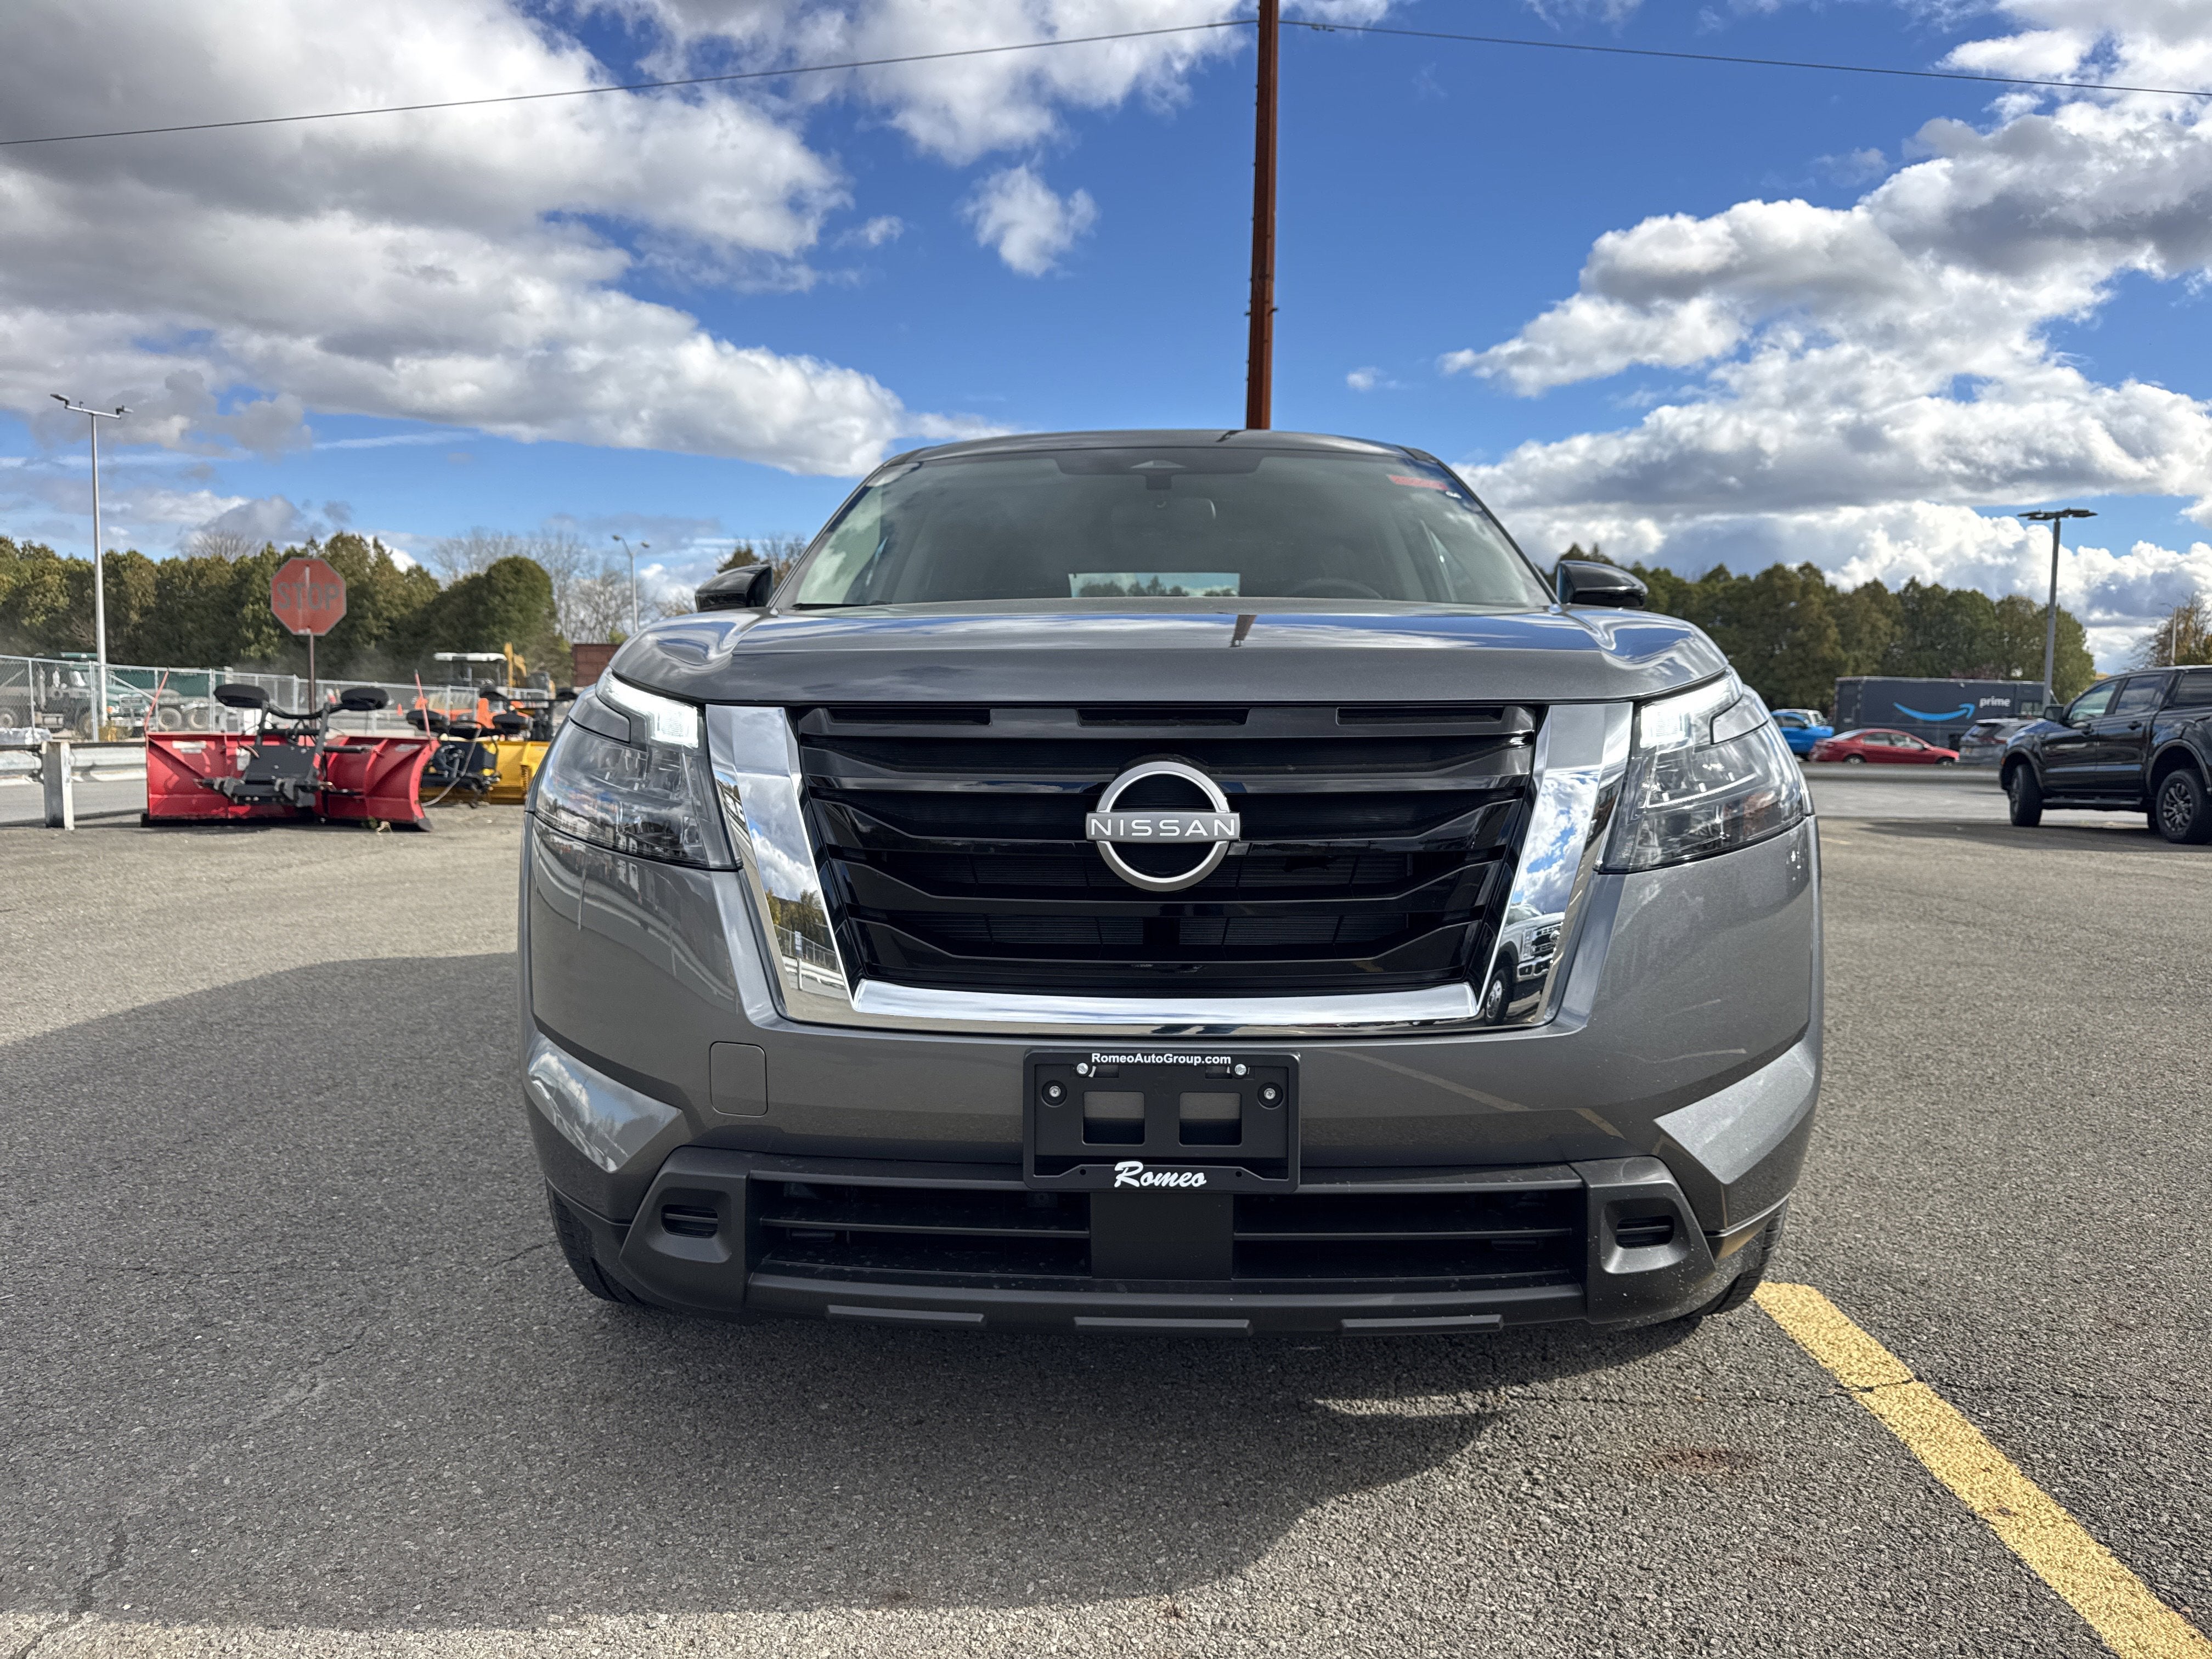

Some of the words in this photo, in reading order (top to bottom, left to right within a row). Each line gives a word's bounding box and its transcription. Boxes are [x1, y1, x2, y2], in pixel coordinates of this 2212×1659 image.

[277, 582, 340, 611] STOP
[1979, 695, 2011, 708] prime
[1091, 819, 1235, 836] NISSAN
[1091, 1053, 1231, 1065] RomeoAutoGroup.com
[1114, 1161, 1207, 1188] Romeo
